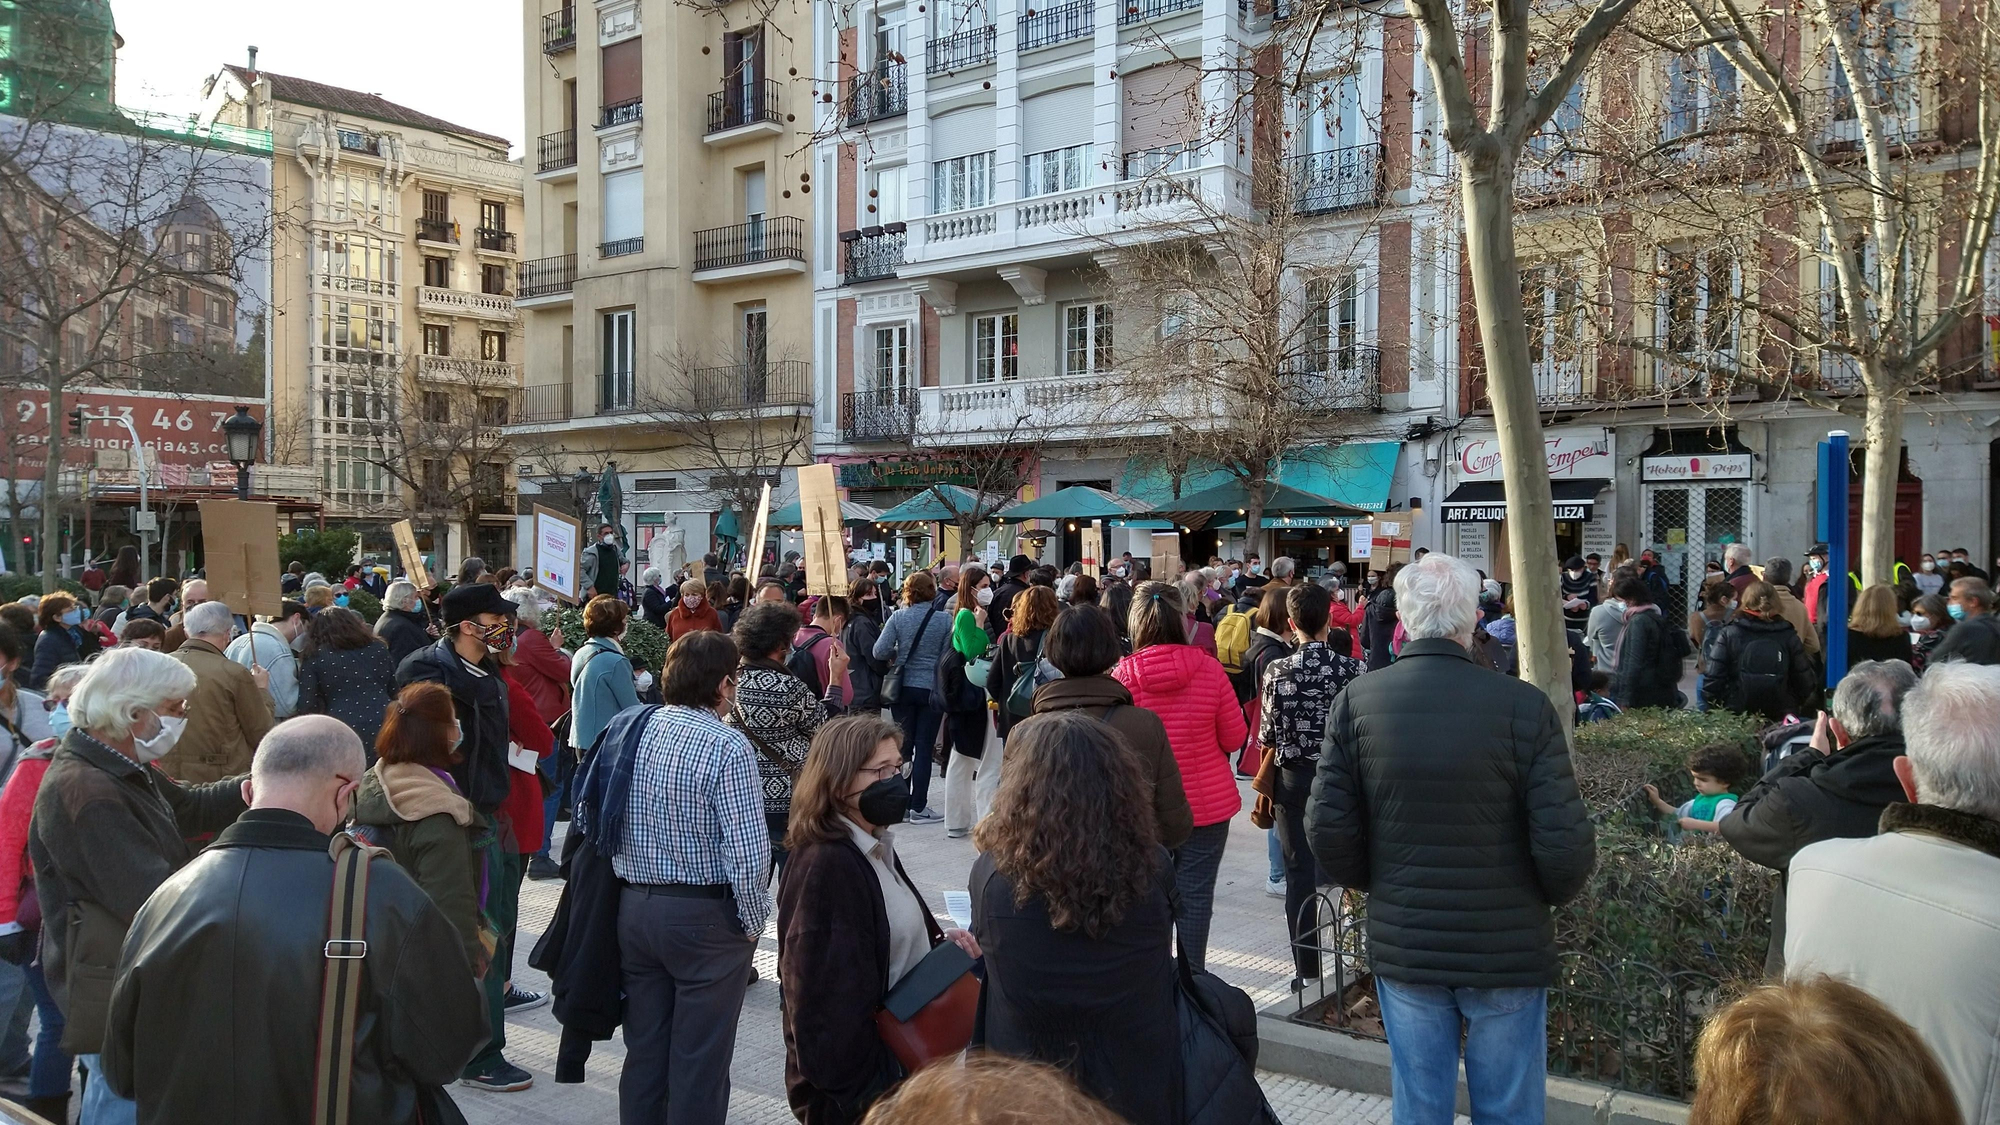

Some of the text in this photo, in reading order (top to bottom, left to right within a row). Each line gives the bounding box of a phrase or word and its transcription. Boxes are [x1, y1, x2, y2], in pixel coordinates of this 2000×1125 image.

[151, 408, 194, 431] 46
[210, 411, 228, 433] 7
[1462, 439, 1502, 477] Comp
[923, 463, 936, 475] Un
[1646, 463, 1743, 477] Hokey Pops
[1447, 508, 1468, 521] ART.
[1553, 506, 1585, 519] LLEZA
[1272, 519, 1284, 527] EL
[1288, 519, 1313, 527] PATIO
[545, 535, 567, 548] TENDIENDO
[547, 541, 565, 553] PUENTES
